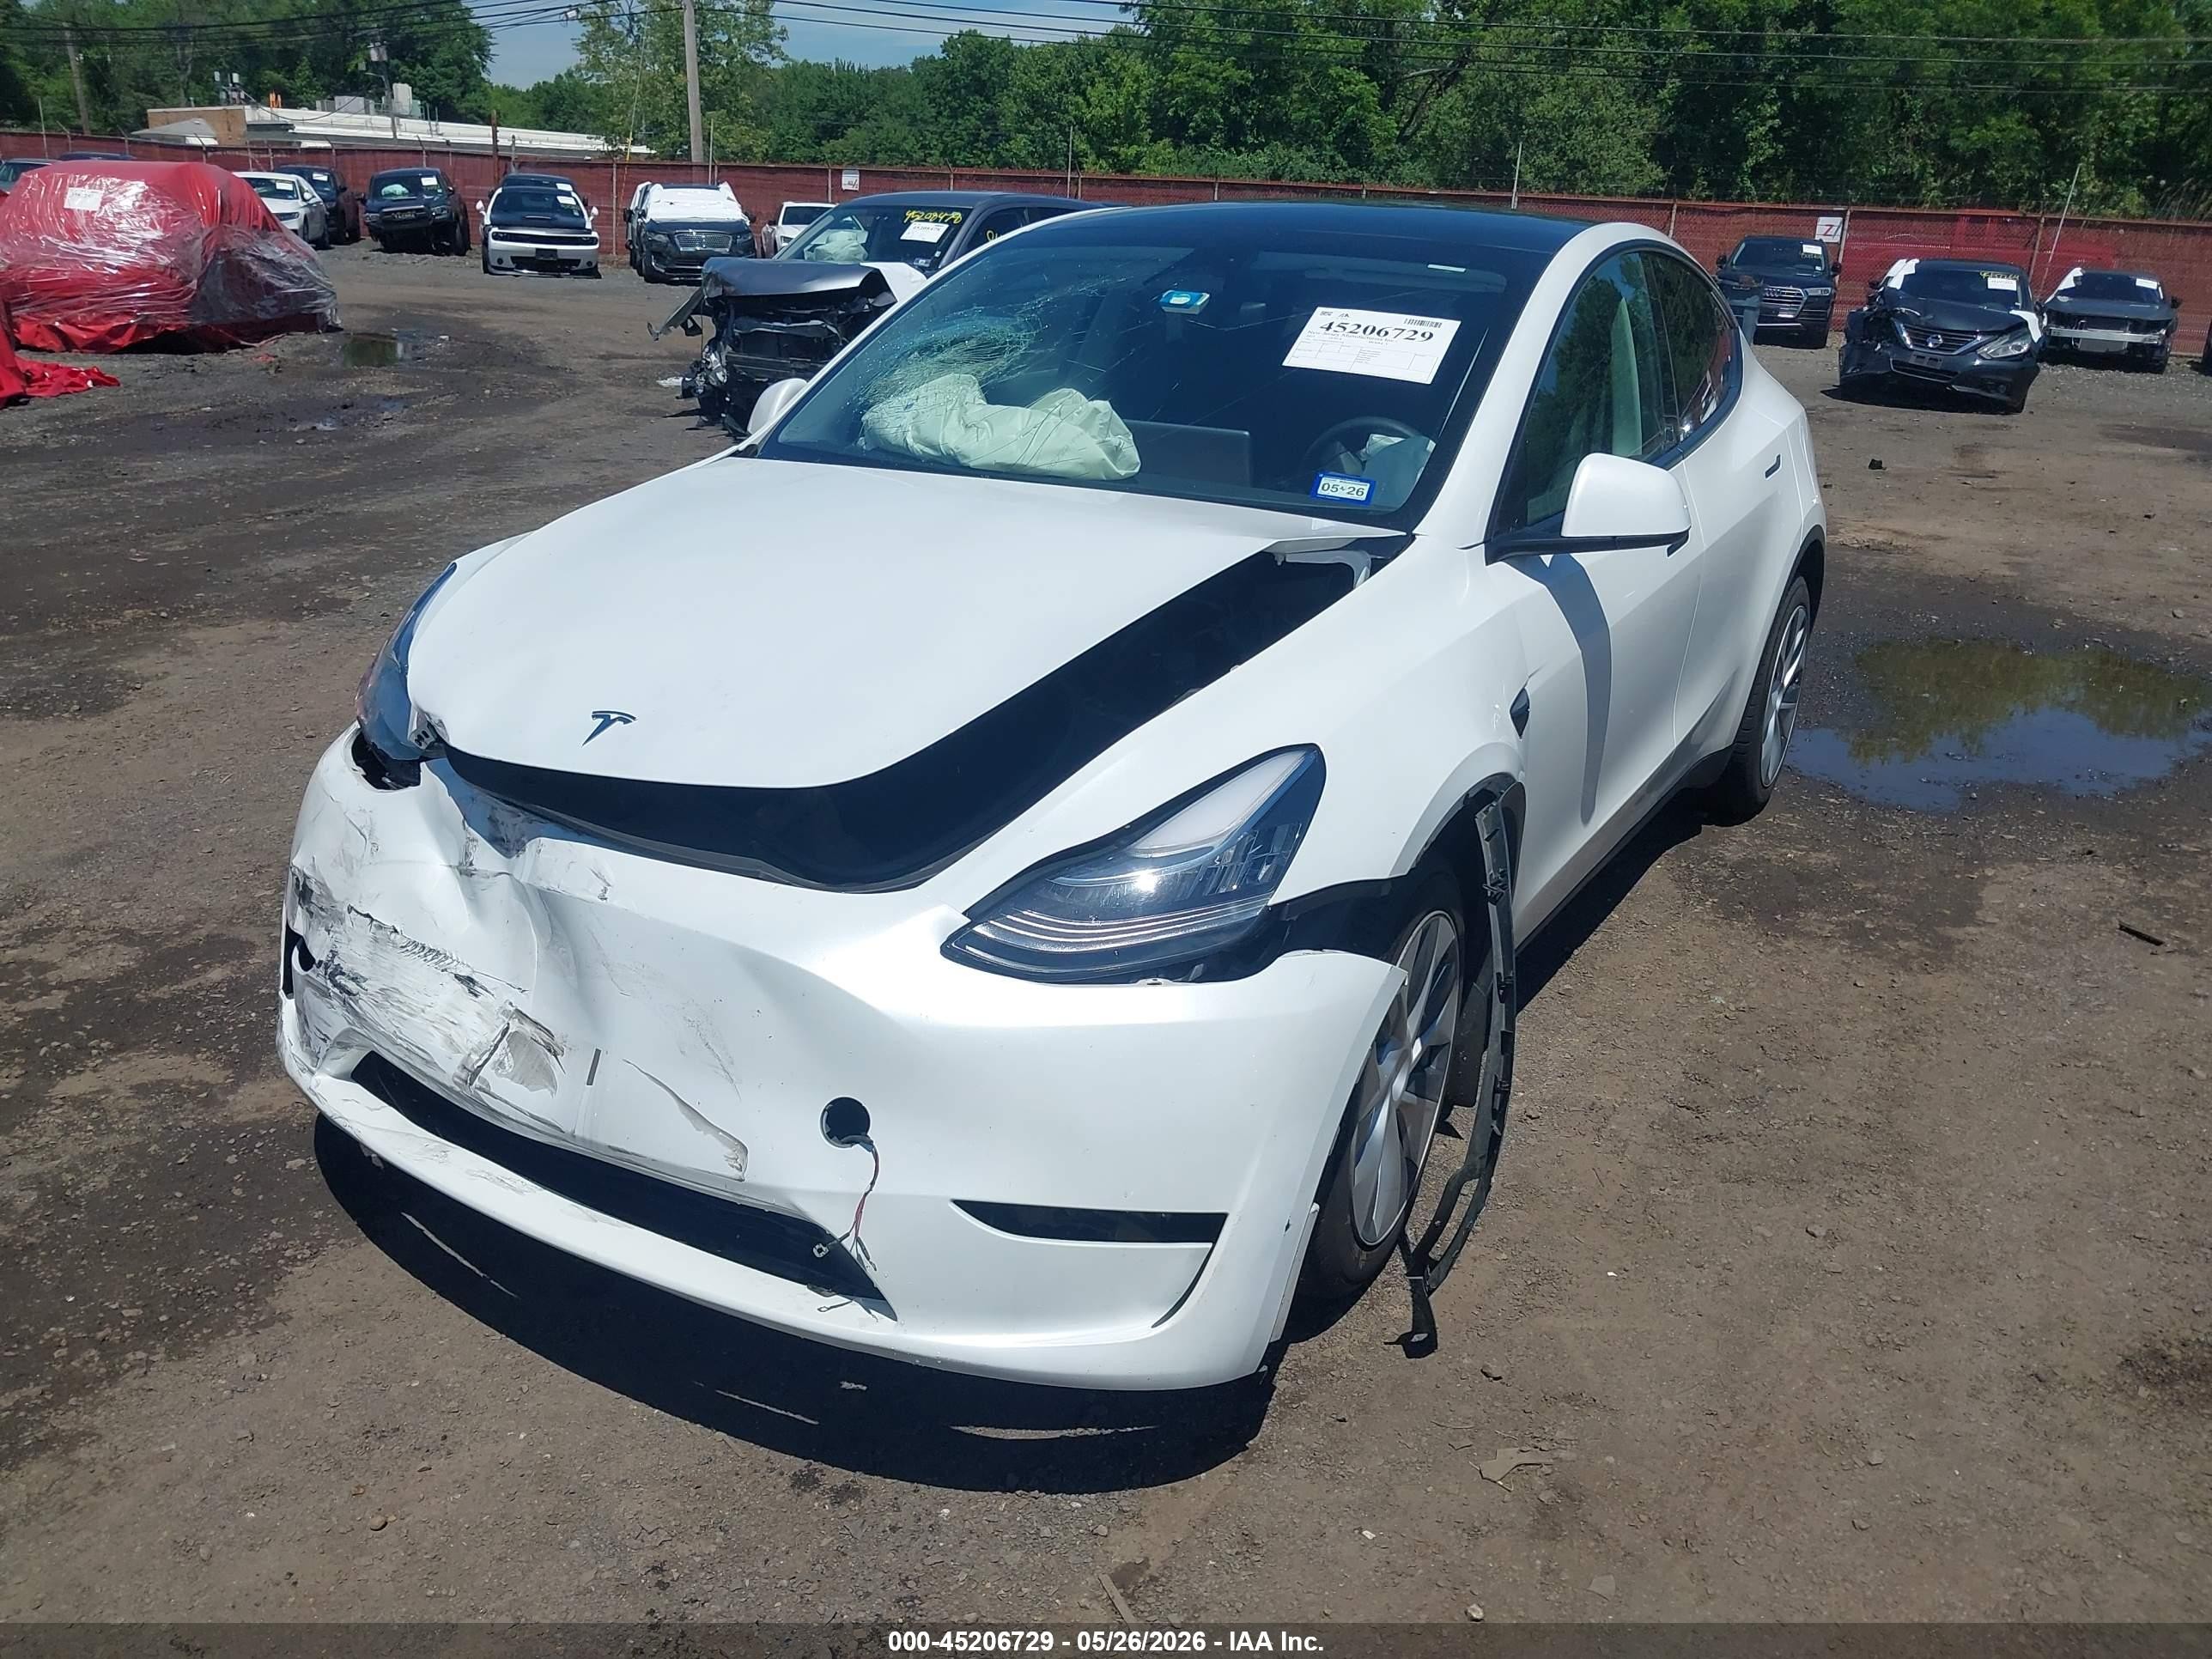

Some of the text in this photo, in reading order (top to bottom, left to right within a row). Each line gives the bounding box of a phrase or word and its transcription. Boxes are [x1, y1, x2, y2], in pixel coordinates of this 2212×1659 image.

[1319, 321, 1434, 343] 45206729
[1322, 483, 1340, 493] 05
[1346, 486, 1365, 497] 26
